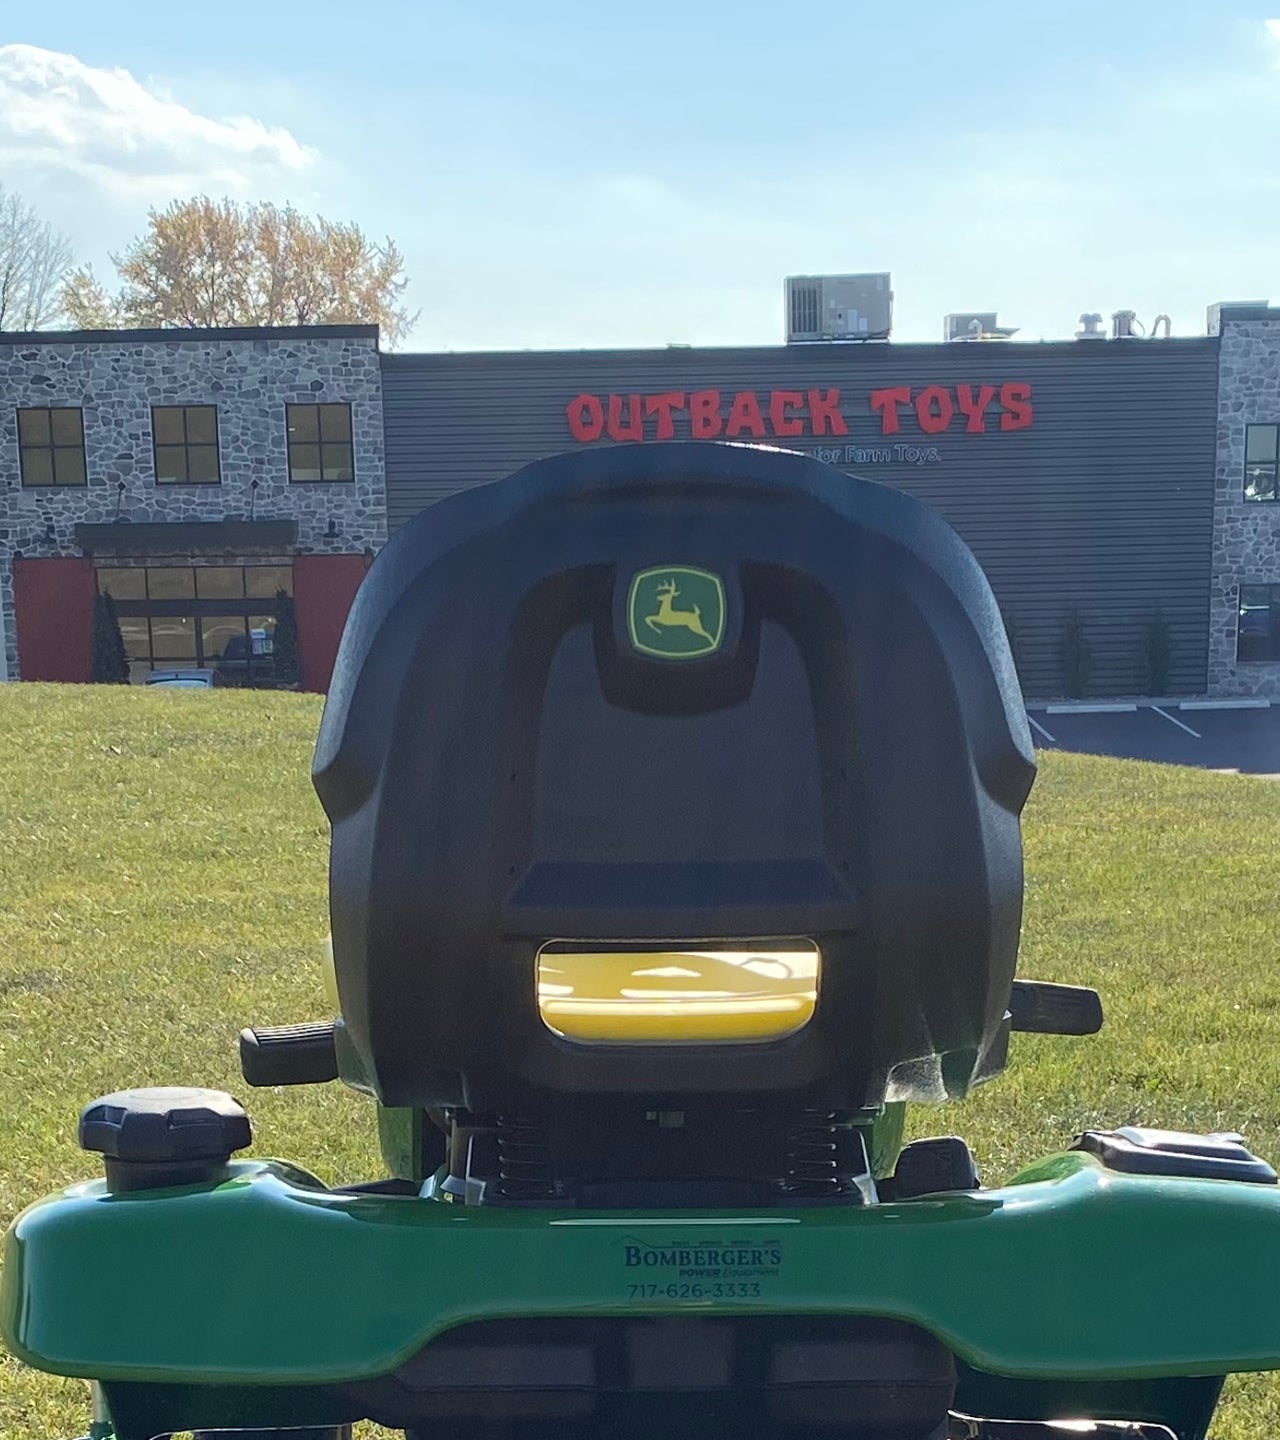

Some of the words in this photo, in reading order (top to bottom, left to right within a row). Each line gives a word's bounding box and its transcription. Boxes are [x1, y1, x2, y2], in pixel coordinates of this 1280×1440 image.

[565, 387, 848, 441] OUTBACK
[871, 383, 1034, 435] TOYS
[845, 446, 891, 463] Farm
[894, 444, 942, 465] Toys.
[624, 1246, 782, 1267] BOMBERGER'S
[627, 1282, 761, 1299] 717-626-3333
